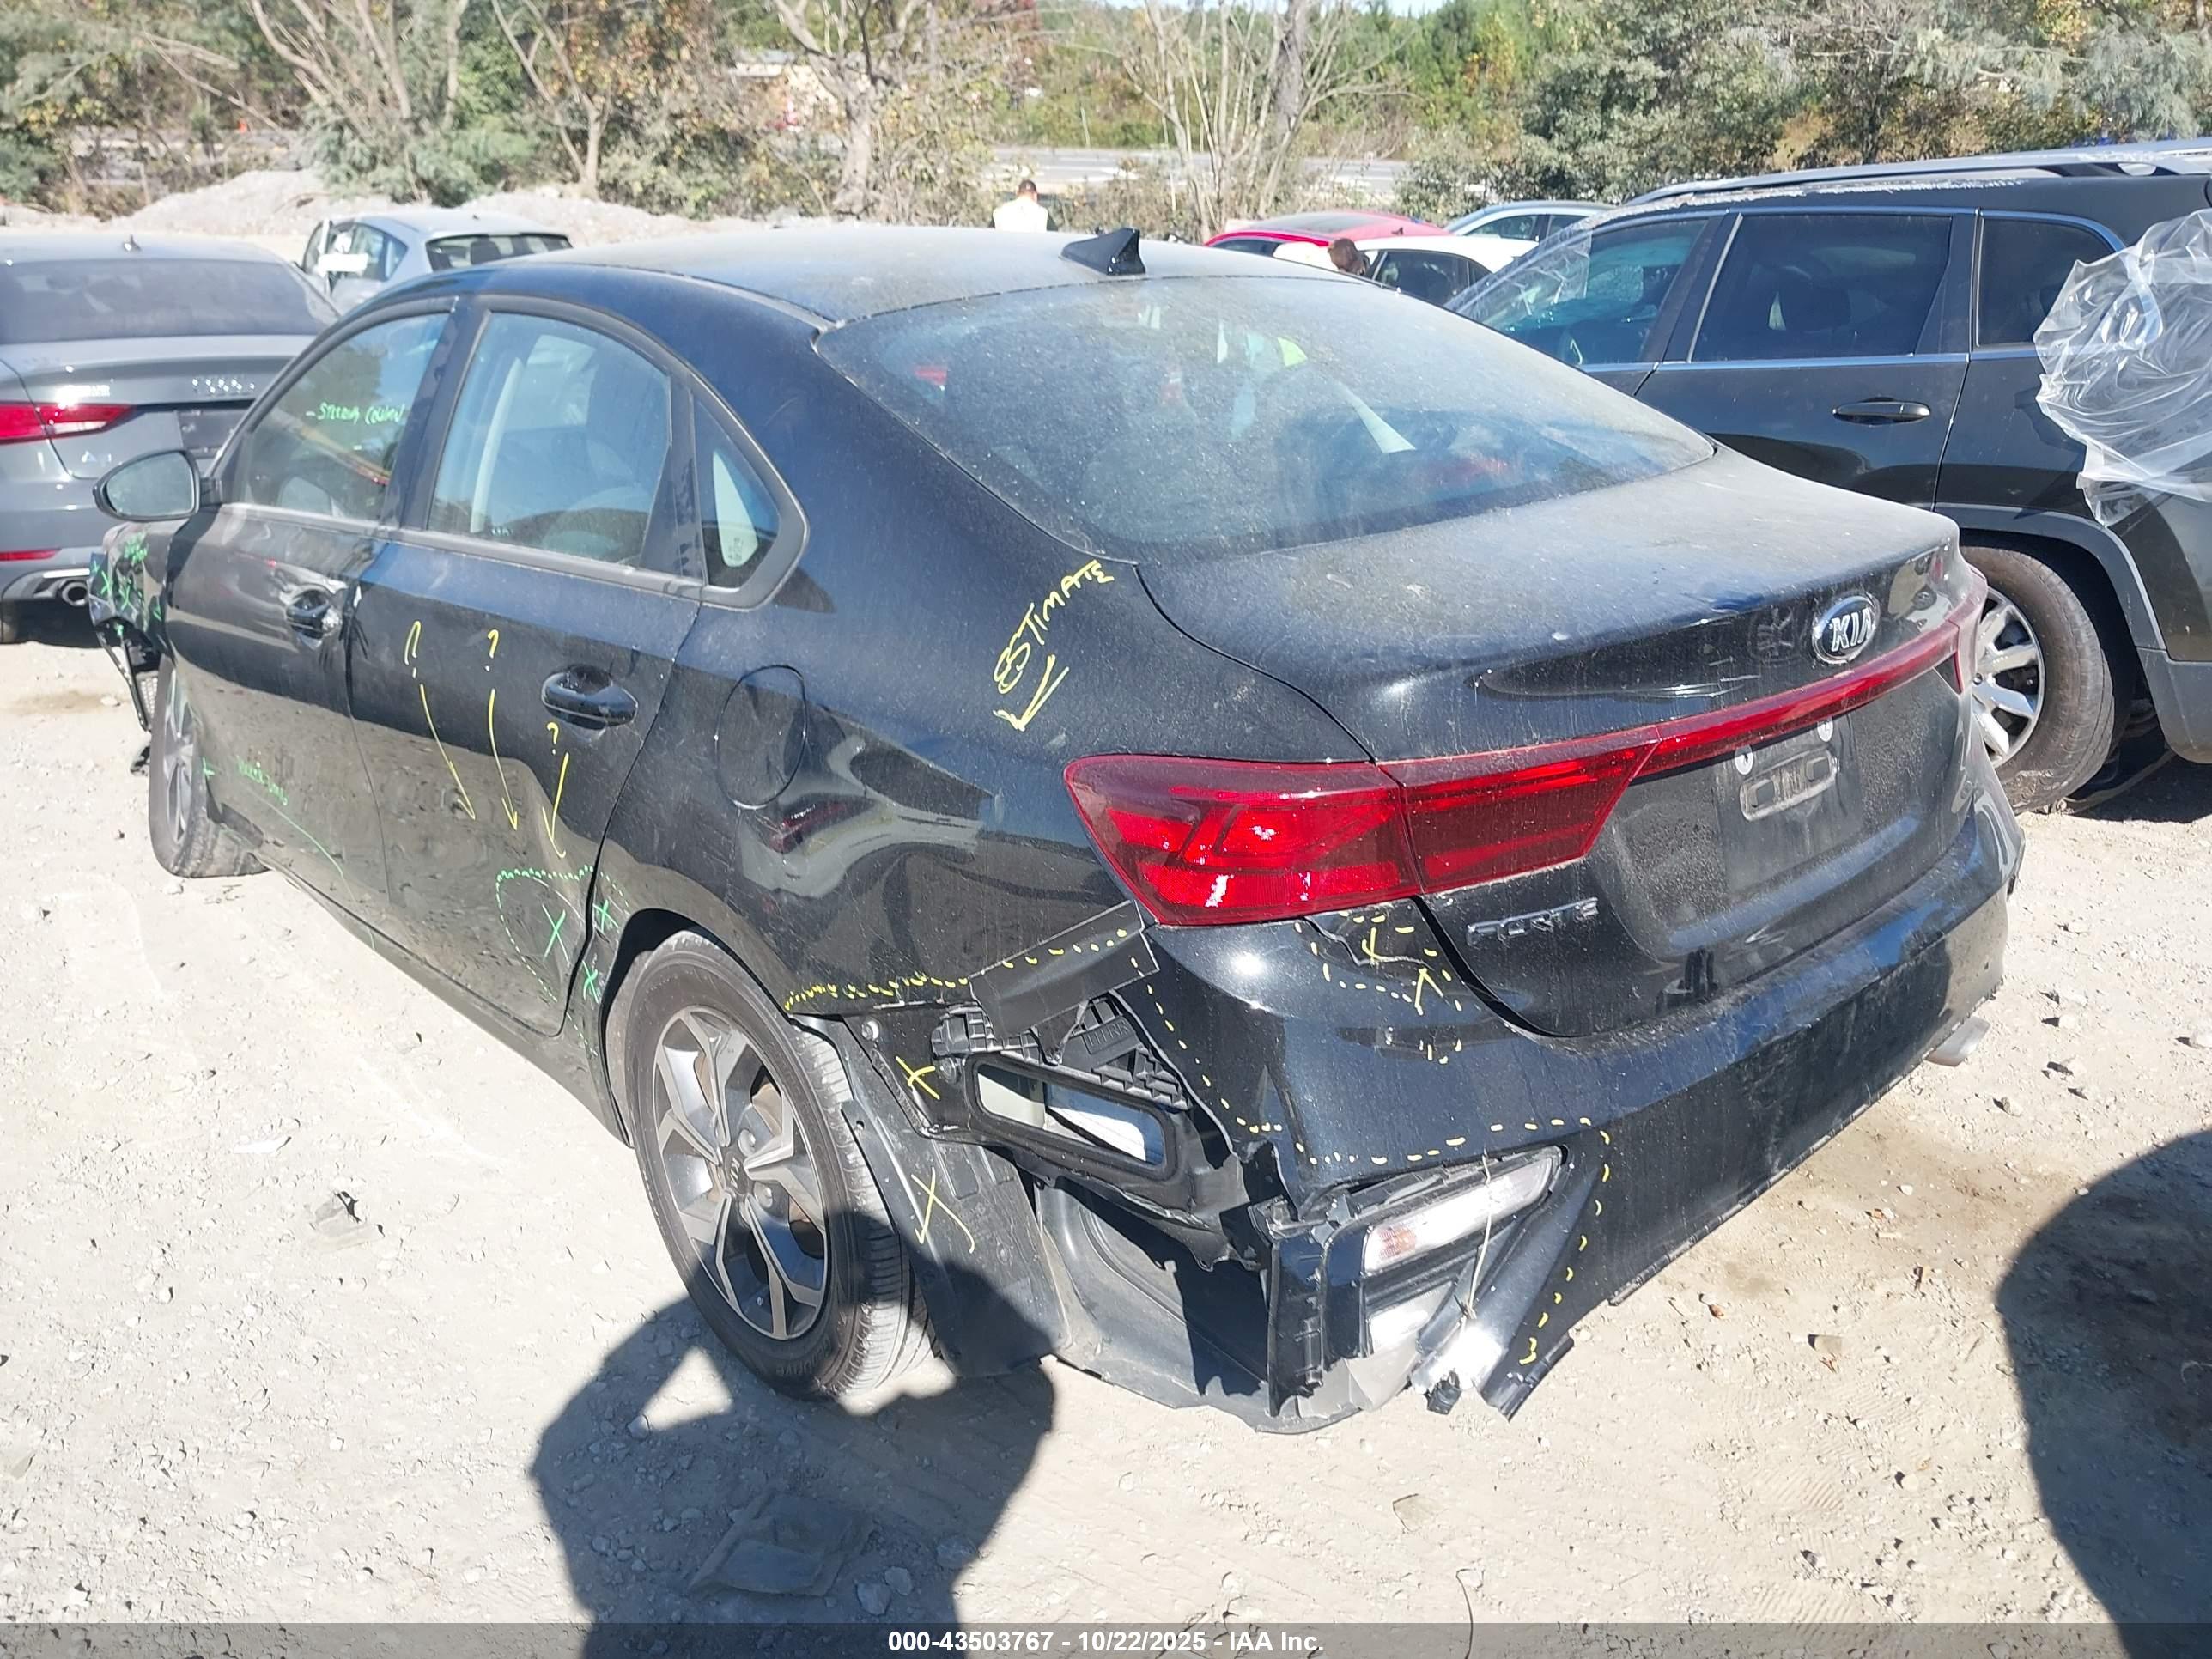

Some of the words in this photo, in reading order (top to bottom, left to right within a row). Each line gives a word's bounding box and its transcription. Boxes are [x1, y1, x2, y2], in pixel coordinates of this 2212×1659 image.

[994, 560, 1115, 694] ESTIMATE
[1831, 606, 1874, 652] KIA
[730, 1156, 740, 1190] KIA
